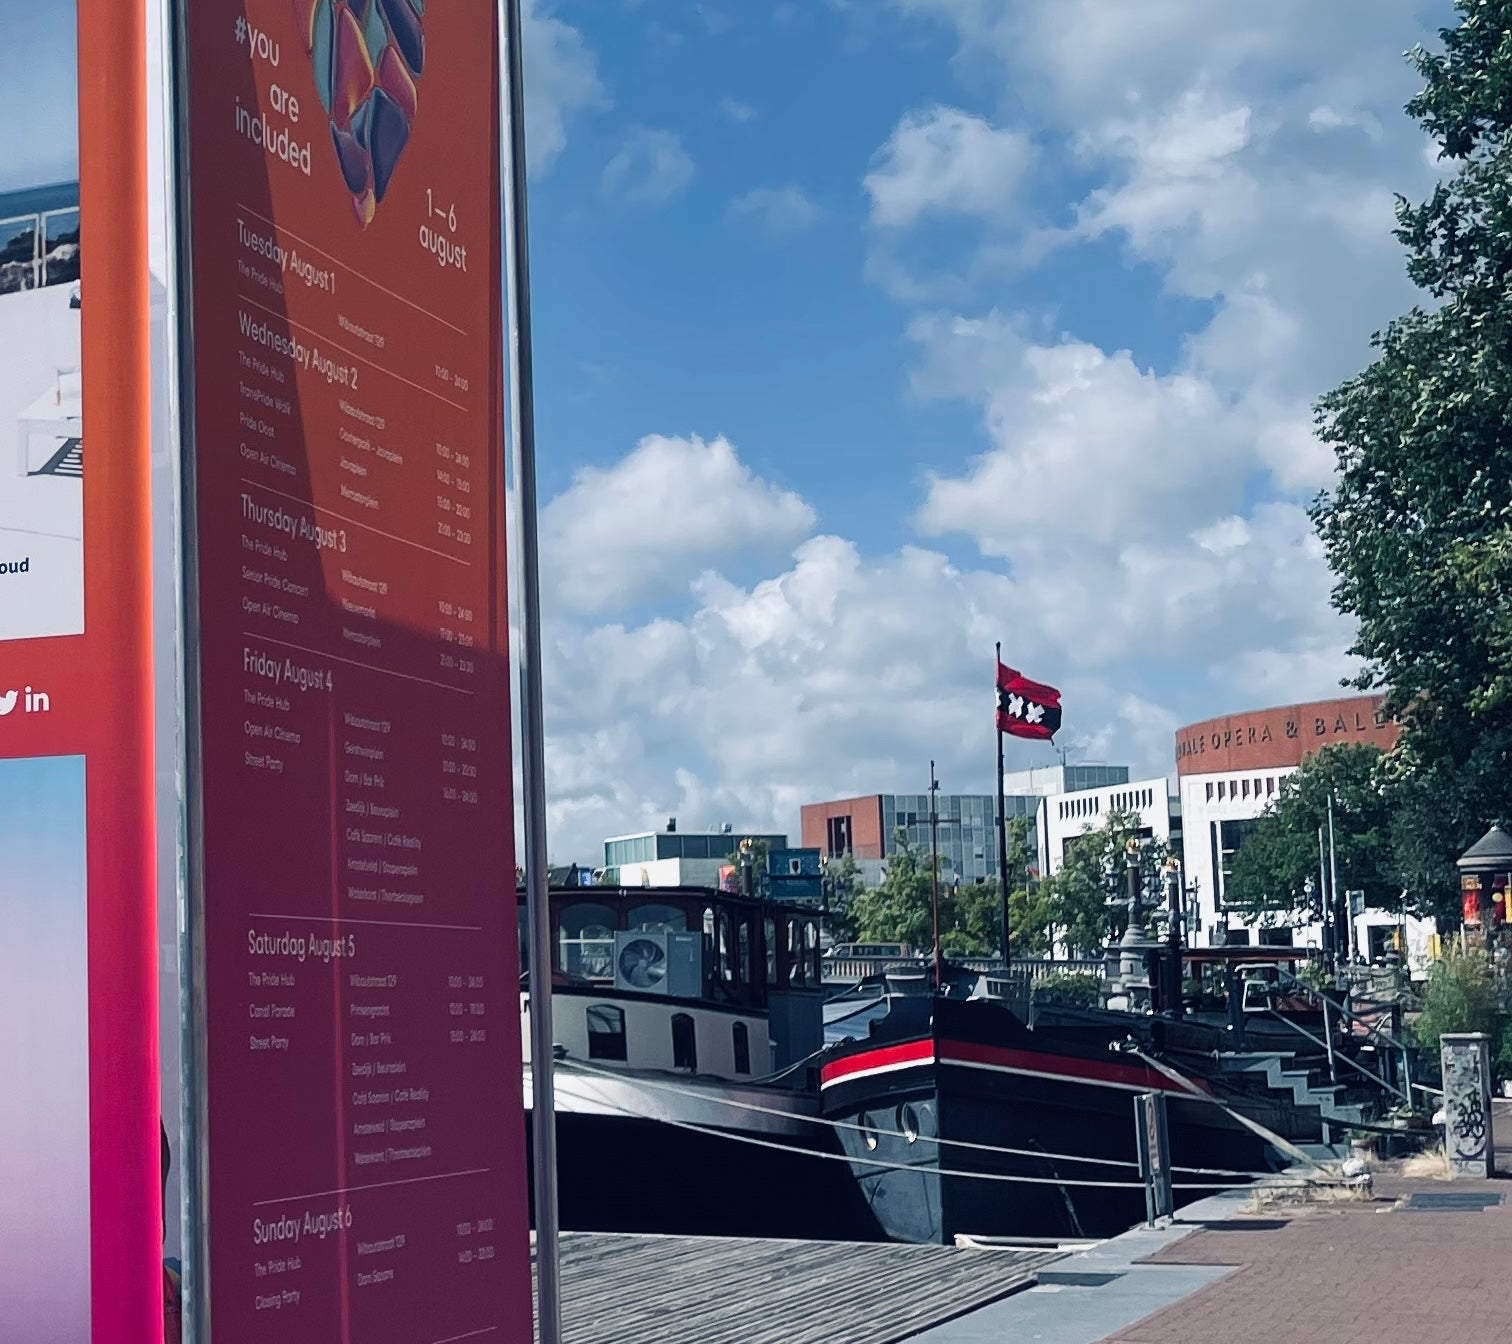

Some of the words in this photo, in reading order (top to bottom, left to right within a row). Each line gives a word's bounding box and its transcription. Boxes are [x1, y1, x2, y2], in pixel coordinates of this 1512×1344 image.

[234, 15, 280, 68] #you
[269, 81, 299, 123] are
[234, 96, 311, 176] included
[237, 219, 287, 271] Tuesday
[290, 251, 328, 290] August
[330, 272, 334, 293] 1
[419, 224, 468, 273] august
[238, 311, 309, 369] Wednesday
[312, 348, 348, 384] August
[350, 367, 357, 389] 2
[241, 494, 297, 538] Thursday
[299, 517, 337, 549] August
[339, 530, 346, 552] 3
[243, 648, 281, 683] Friday
[283, 659, 323, 691] August
[325, 671, 332, 691] 4
[1211, 723, 1273, 750] OPERA
[1286, 720, 1298, 738] &
[308, 934, 345, 962] August
[348, 934, 355, 957] 5
[253, 1215, 300, 1244] Sunday
[303, 1208, 343, 1239] August
[345, 1206, 352, 1227] 6
